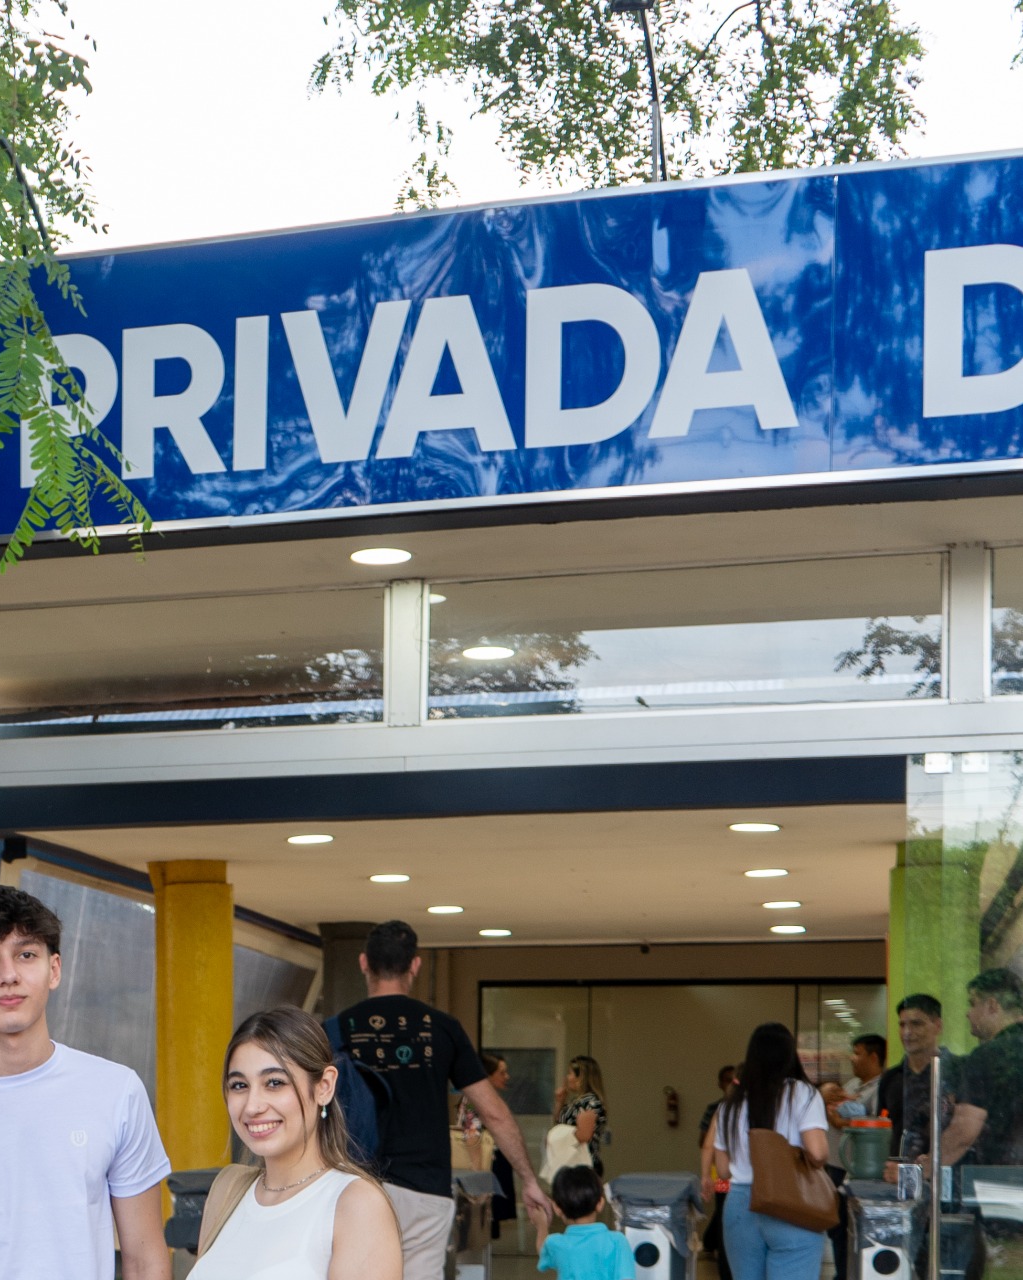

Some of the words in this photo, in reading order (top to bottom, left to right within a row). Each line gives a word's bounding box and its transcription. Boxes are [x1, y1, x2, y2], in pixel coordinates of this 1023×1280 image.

[20, 268, 799, 489] PRIVADA
[923, 243, 1023, 418] D
[398, 1015, 407, 1027] 3
[422, 1013, 432, 1024] 4
[376, 1047, 386, 1059] 6
